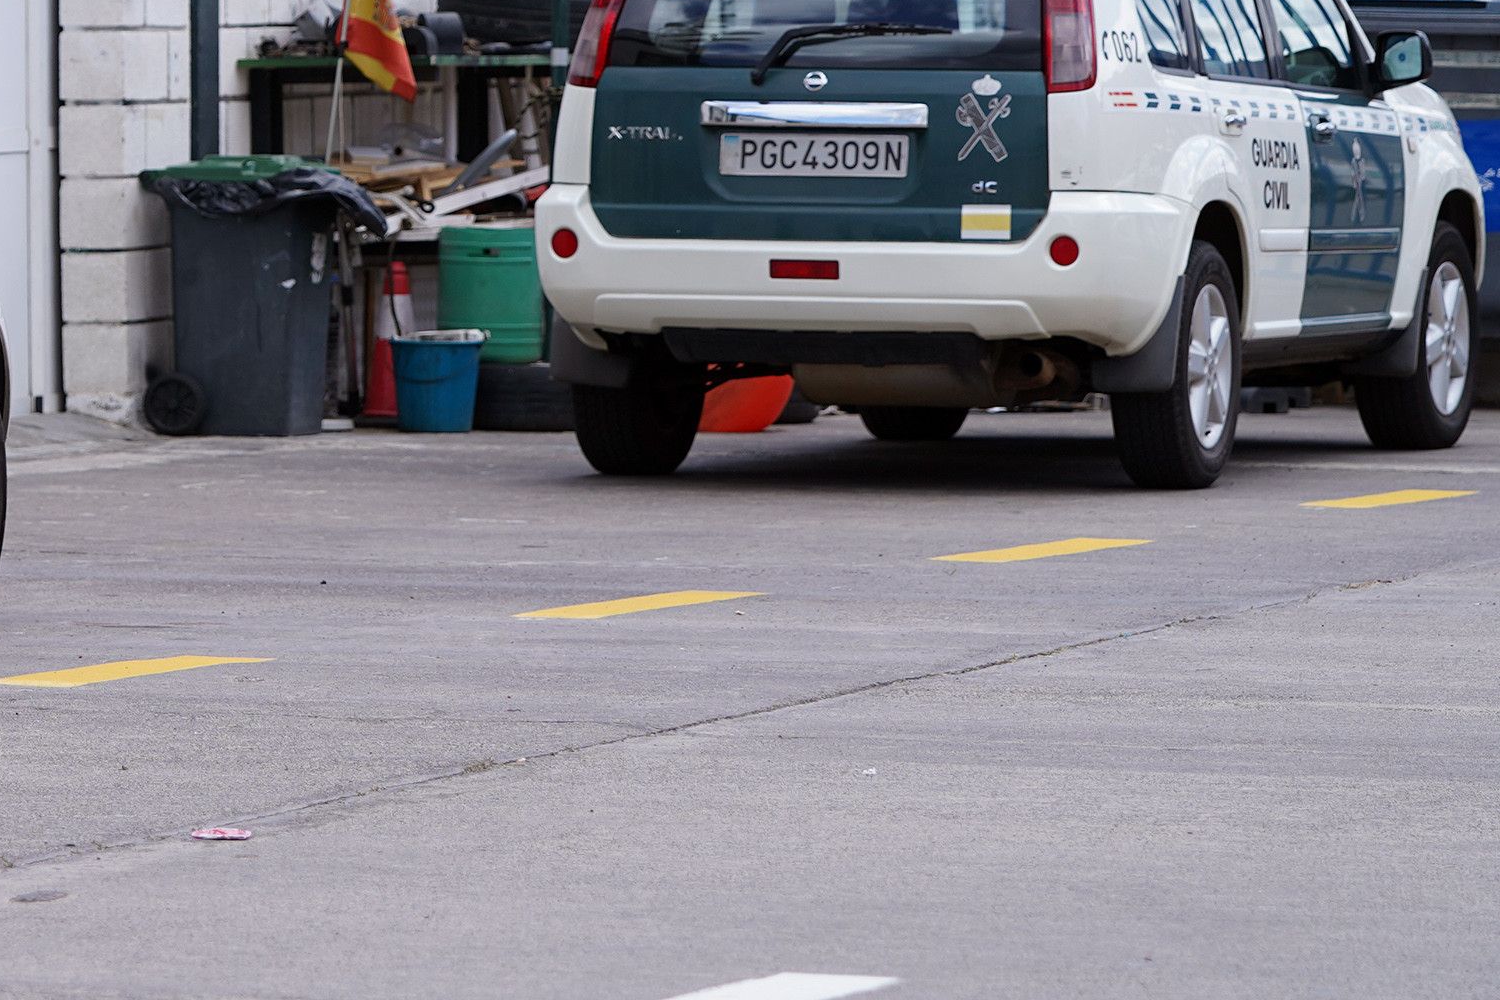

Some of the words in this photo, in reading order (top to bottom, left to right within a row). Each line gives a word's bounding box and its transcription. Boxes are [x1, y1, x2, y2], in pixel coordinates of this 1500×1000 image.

[1111, 30, 1142, 63] 062
[741, 139, 902, 171] PGC4309N
[1251, 138, 1300, 171] GUARDIA
[1263, 180, 1290, 210] CIVIL
